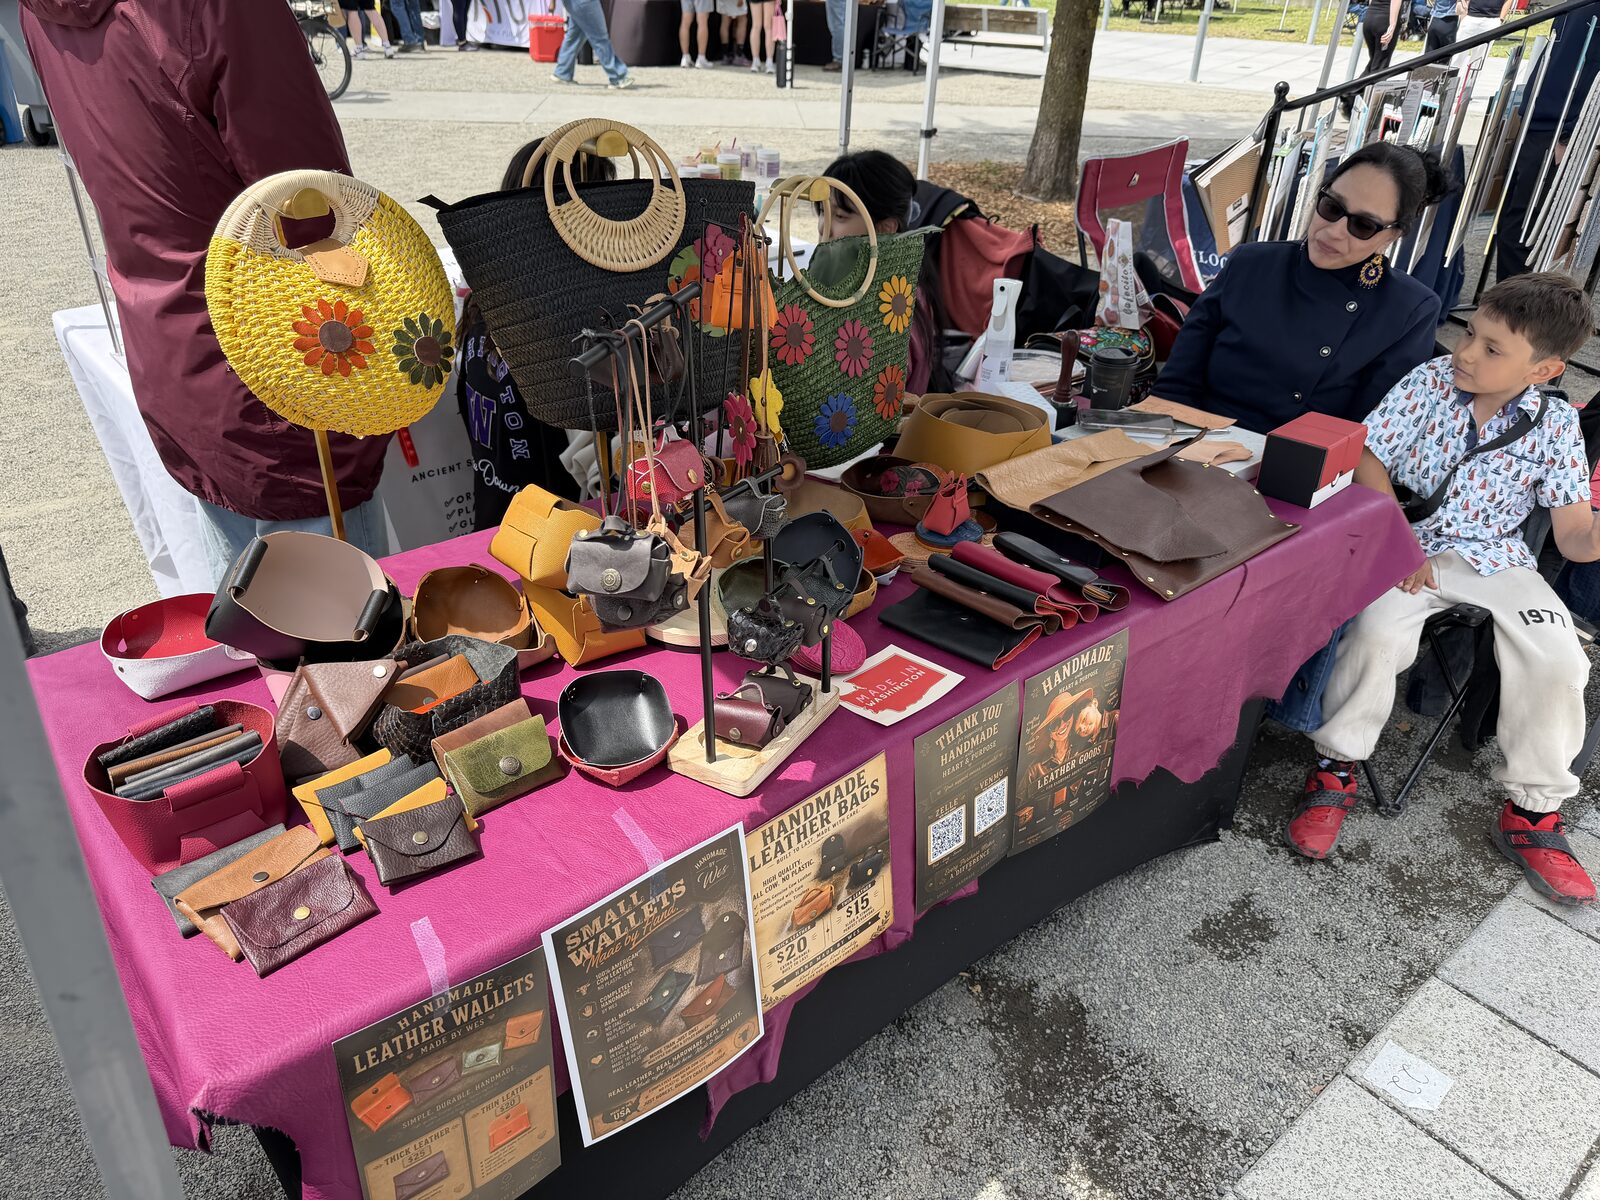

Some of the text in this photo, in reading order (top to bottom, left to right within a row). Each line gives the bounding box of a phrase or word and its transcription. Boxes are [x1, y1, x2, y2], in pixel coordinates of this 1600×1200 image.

[465, 382, 497, 448] W
[412, 462, 461, 483] ANCIENT
[856, 665, 918, 704] MADE IN
[1041, 645, 1113, 695] HANDMADE
[1058, 681, 1073, 694] HEART
[1079, 668, 1098, 683] PURPOSE
[866, 669, 926, 707] WASHINGTON
[935, 710, 978, 750] THANK
[982, 703, 1002, 722] YOU
[940, 722, 998, 766] HANDMADE
[942, 760, 963, 778] HEART
[964, 756, 969, 765] &
[971, 739, 996, 761] PURPOSE
[979, 767, 1003, 789] VENMO
[1036, 744, 1101, 790] LEATHER GOODS
[761, 768, 865, 847] HANDMADE
[935, 797, 958, 817] ZELLE
[749, 777, 879, 873] LEATHER BAGS
[776, 851, 791, 864] BUILT
[816, 826, 830, 838] MADE
[832, 817, 844, 828] WITH
[694, 847, 727, 870] HANDMADE
[697, 858, 729, 891] Wes
[955, 848, 989, 876] DIFFERENCE
[752, 889, 763, 901] ALL
[781, 873, 789, 883] NO
[791, 857, 814, 877] PLASTIC.
[762, 873, 776, 887] HIGH
[797, 871, 811, 882] Leather
[564, 887, 644, 952] SMALL
[846, 892, 869, 920] $15
[567, 877, 686, 970] WALLETS
[581, 937, 622, 975] Made
[623, 928, 640, 949] by
[611, 951, 639, 971] AMERICAN
[776, 934, 807, 967] $20
[795, 928, 859, 976] HAND MADE BY WES
[596, 960, 632, 985] COW LEATHER
[597, 983, 604, 991] NO
[397, 977, 494, 1030] HANDMADE
[599, 980, 632, 1003] COMPLETELY
[600, 987, 630, 1009] HANDMADE
[353, 971, 534, 1074] LEATHER WALLETS
[603, 994, 653, 1027] REAL METAL SNAPS
[420, 1017, 484, 1054] MADE BY WES
[609, 1041, 623, 1054] MADE
[624, 1033, 638, 1045] WITH
[607, 1085, 624, 1098] REAL
[656, 1058, 670, 1071] REAL
[705, 1027, 718, 1040] REAL
[480, 1098, 500, 1114] THIN
[502, 1079, 533, 1102] LEATHER
[499, 1098, 515, 1112] $20
[613, 1106, 630, 1121] USA
[643, 1096, 654, 1107] JUST
[385, 1126, 449, 1165] THICK LEATHER
[407, 1148, 425, 1163] $25
